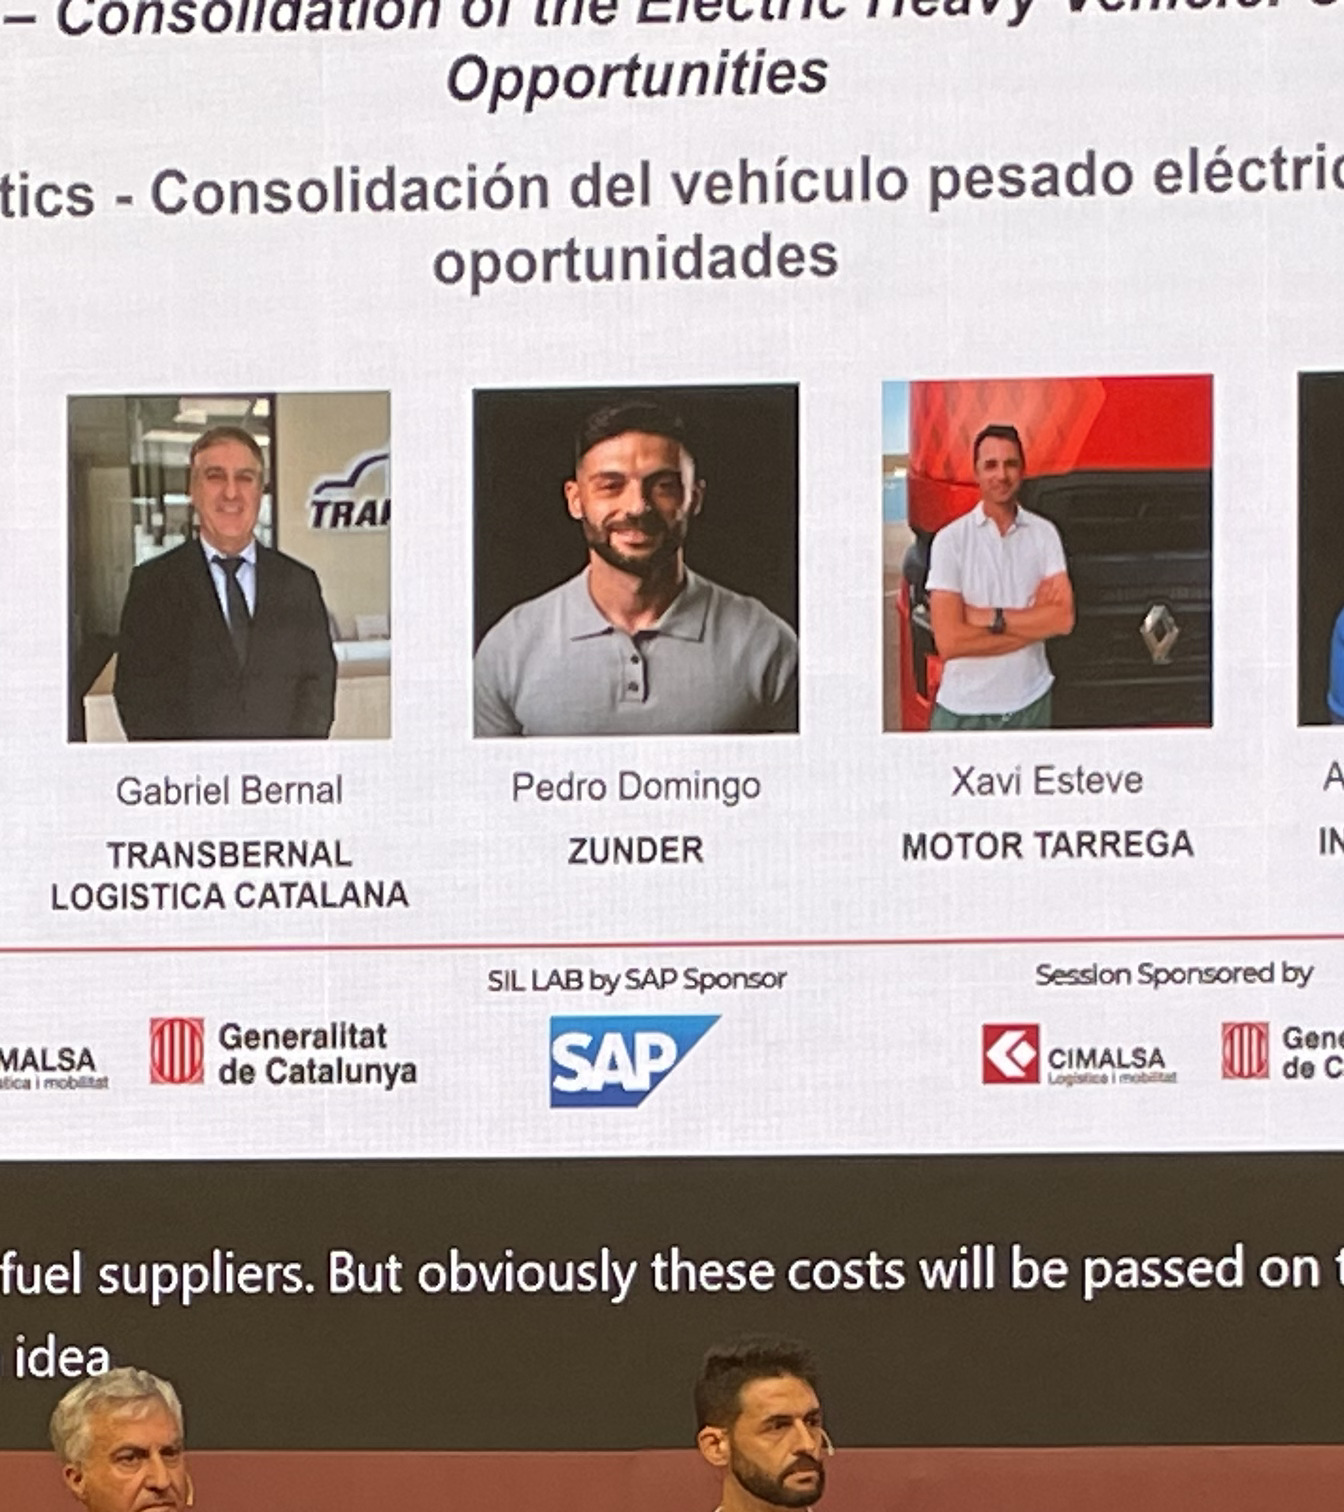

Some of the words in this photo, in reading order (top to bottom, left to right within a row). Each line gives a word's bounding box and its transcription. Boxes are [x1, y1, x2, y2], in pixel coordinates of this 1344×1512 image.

[448, 48, 828, 113] Opportunities
[152, 163, 548, 215] Consolidación
[571, 160, 649, 208] del
[672, 155, 908, 205] vehículo
[931, 150, 1133, 212] pesado
[434, 232, 837, 295] oportunidades
[117, 776, 229, 805] Gabriel
[242, 774, 342, 804] Bernal
[513, 772, 606, 801] Pedro
[619, 771, 761, 807] Domingo
[953, 766, 1020, 796] Xavi
[1035, 765, 1143, 795] Esteve
[107, 840, 352, 868] TRANSBERNAL
[568, 836, 703, 864] ZUNDER
[903, 832, 1022, 860] MOTOR
[1034, 830, 1194, 858] TARREGA
[52, 883, 225, 910] LOGISTICA
[235, 881, 409, 908] CATALANA
[489, 970, 526, 991] SIL
[532, 969, 583, 991] LAB
[590, 969, 621, 996] by
[625, 968, 678, 990] SAP
[684, 968, 787, 994] Sponsor
[1036, 963, 1131, 986] Session
[1138, 962, 1274, 989] Sponsored
[1282, 961, 1314, 988] by
[219, 1022, 387, 1050] Generalitat
[552, 1031, 679, 1093] SAP
[1048, 1047, 1165, 1069] CIMALSA
[1283, 1056, 1315, 1079] de
[219, 1058, 255, 1085] de
[266, 1057, 416, 1091] Catalunya
[0, 1250, 80, 1294] fuel
[99, 1249, 314, 1305] suppliers.
[331, 1251, 402, 1292] But
[419, 1248, 637, 1303] obviously
[651, 1247, 775, 1291] these
[789, 1252, 905, 1290] costs
[919, 1245, 994, 1288] will
[1013, 1245, 1068, 1288] be
[1085, 1243, 1243, 1300] passed
[1261, 1257, 1319, 1287] on
[17, 1333, 110, 1377] idea
